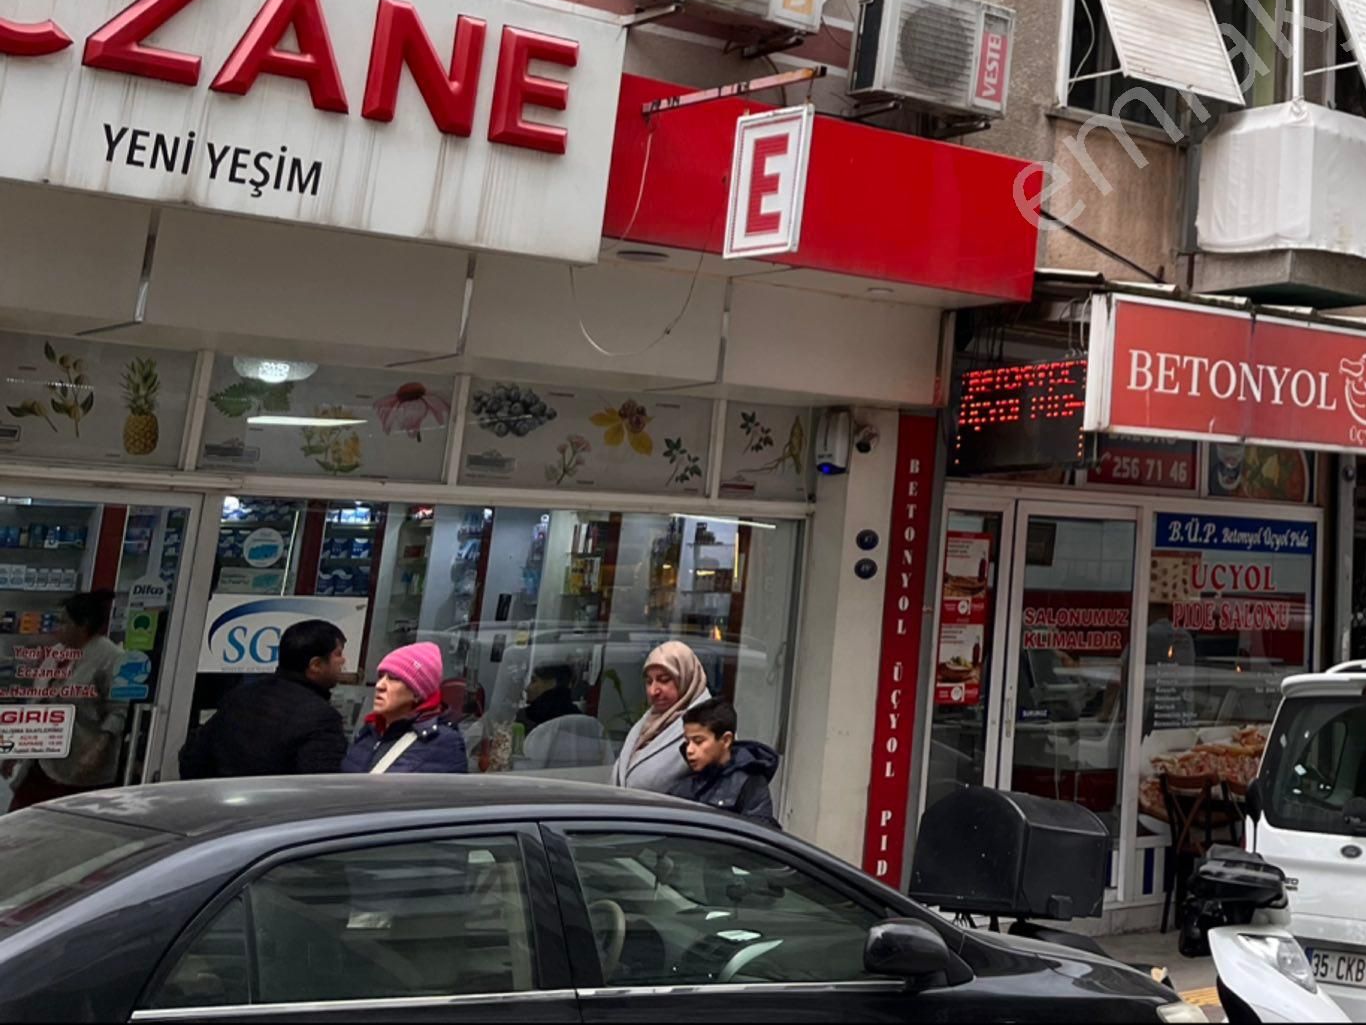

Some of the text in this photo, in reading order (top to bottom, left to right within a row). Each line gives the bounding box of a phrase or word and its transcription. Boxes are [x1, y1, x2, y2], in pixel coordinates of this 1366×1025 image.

[103, 124, 323, 198] YENİ YEŞİM
[744, 133, 789, 236] E
[1127, 349, 1337, 412] BETONYOL
[1112, 457, 1188, 483] 256 71 46
[1023, 607, 1130, 626] SALONUMUZ
[1220, 600, 1291, 630] SALONU
[223, 626, 282, 664] SG
[875, 460, 921, 877] BETONYOL ÜÇYOL PID
[1, 707, 65, 726] GİRİŞ
[1313, 952, 1329, 978] 35
[1336, 956, 1366, 982] CKB
